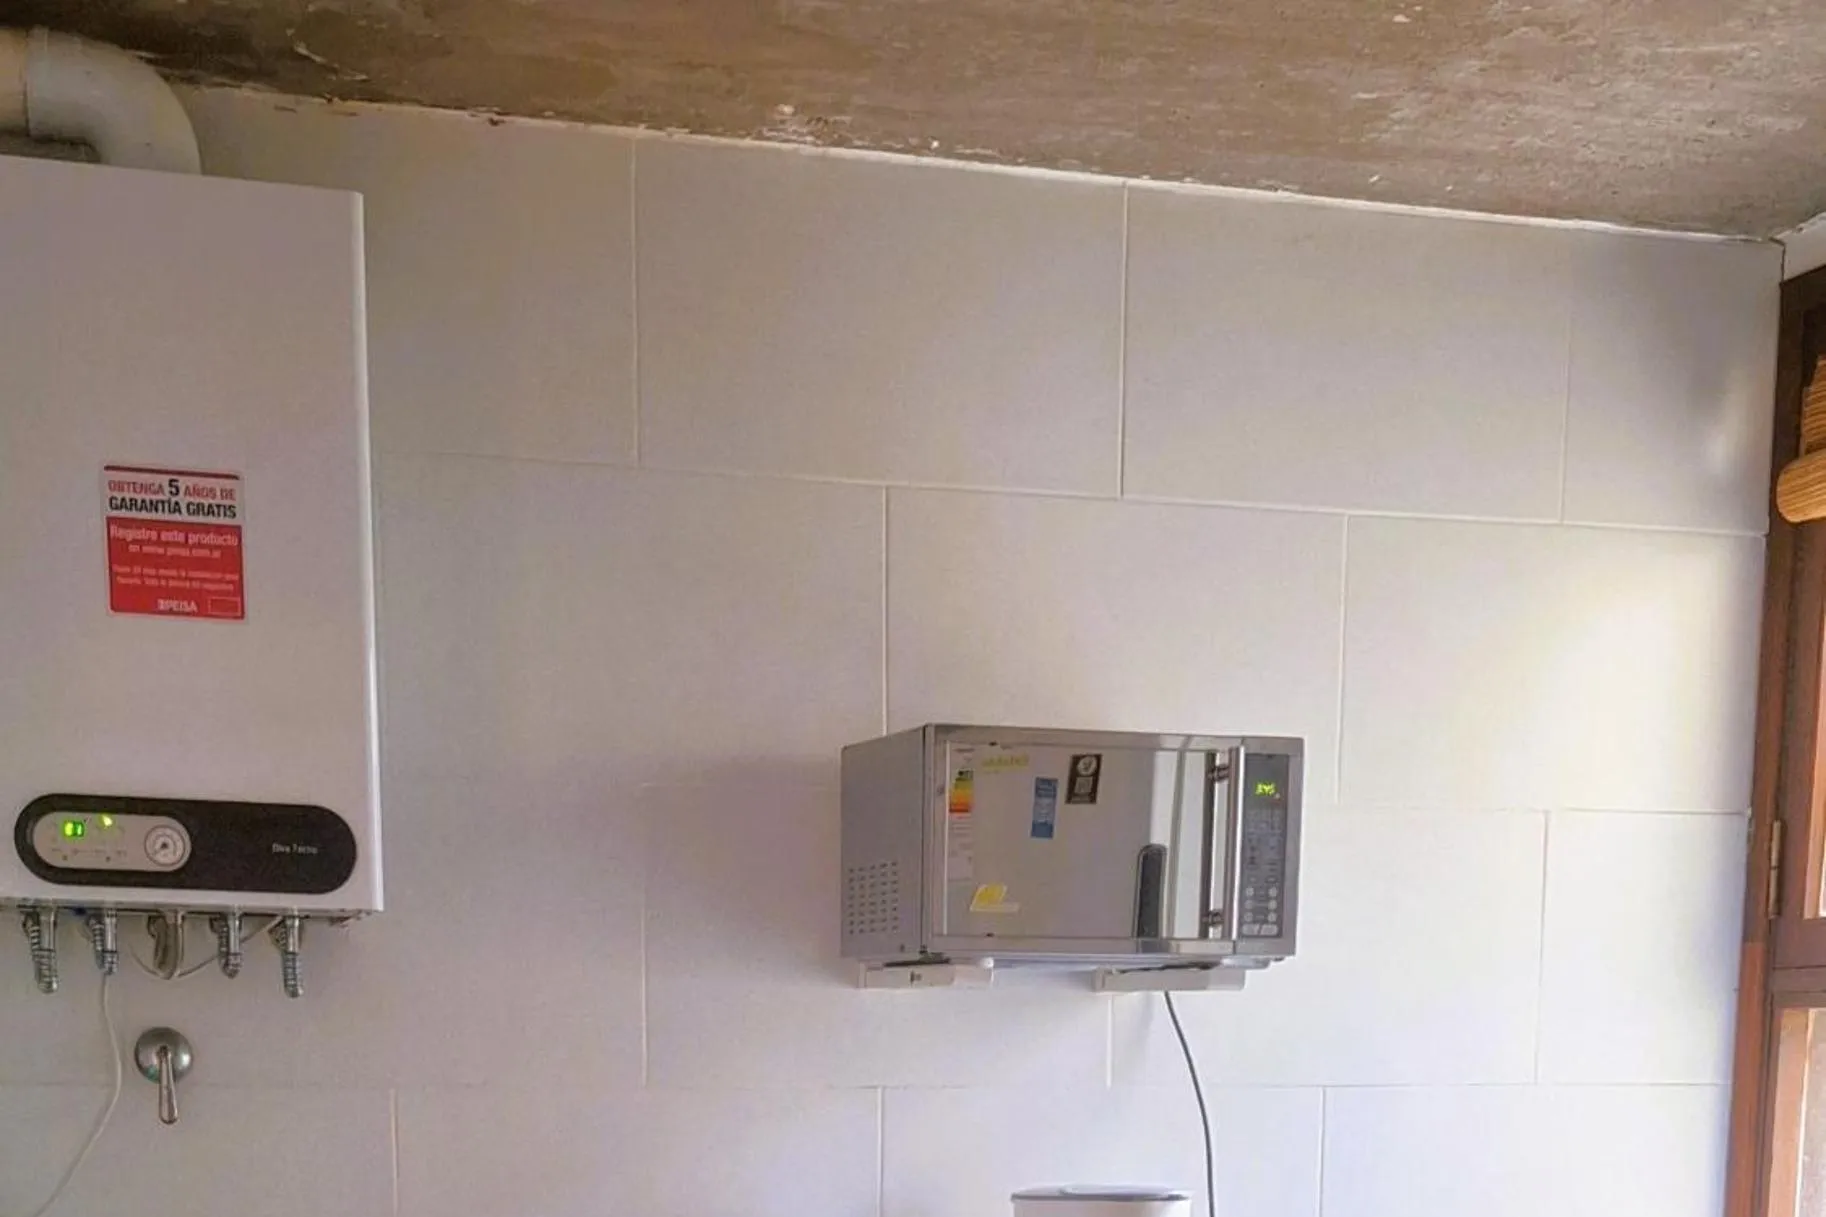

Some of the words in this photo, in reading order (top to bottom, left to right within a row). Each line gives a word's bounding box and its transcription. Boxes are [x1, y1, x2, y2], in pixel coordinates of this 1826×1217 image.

[168, 479, 180, 497] 5
[184, 483, 217, 500] AÑOS
[220, 487, 236, 501] DE
[109, 496, 182, 516] GARANTÍA
[186, 501, 237, 519] GRATIS
[188, 532, 238, 547] producto
